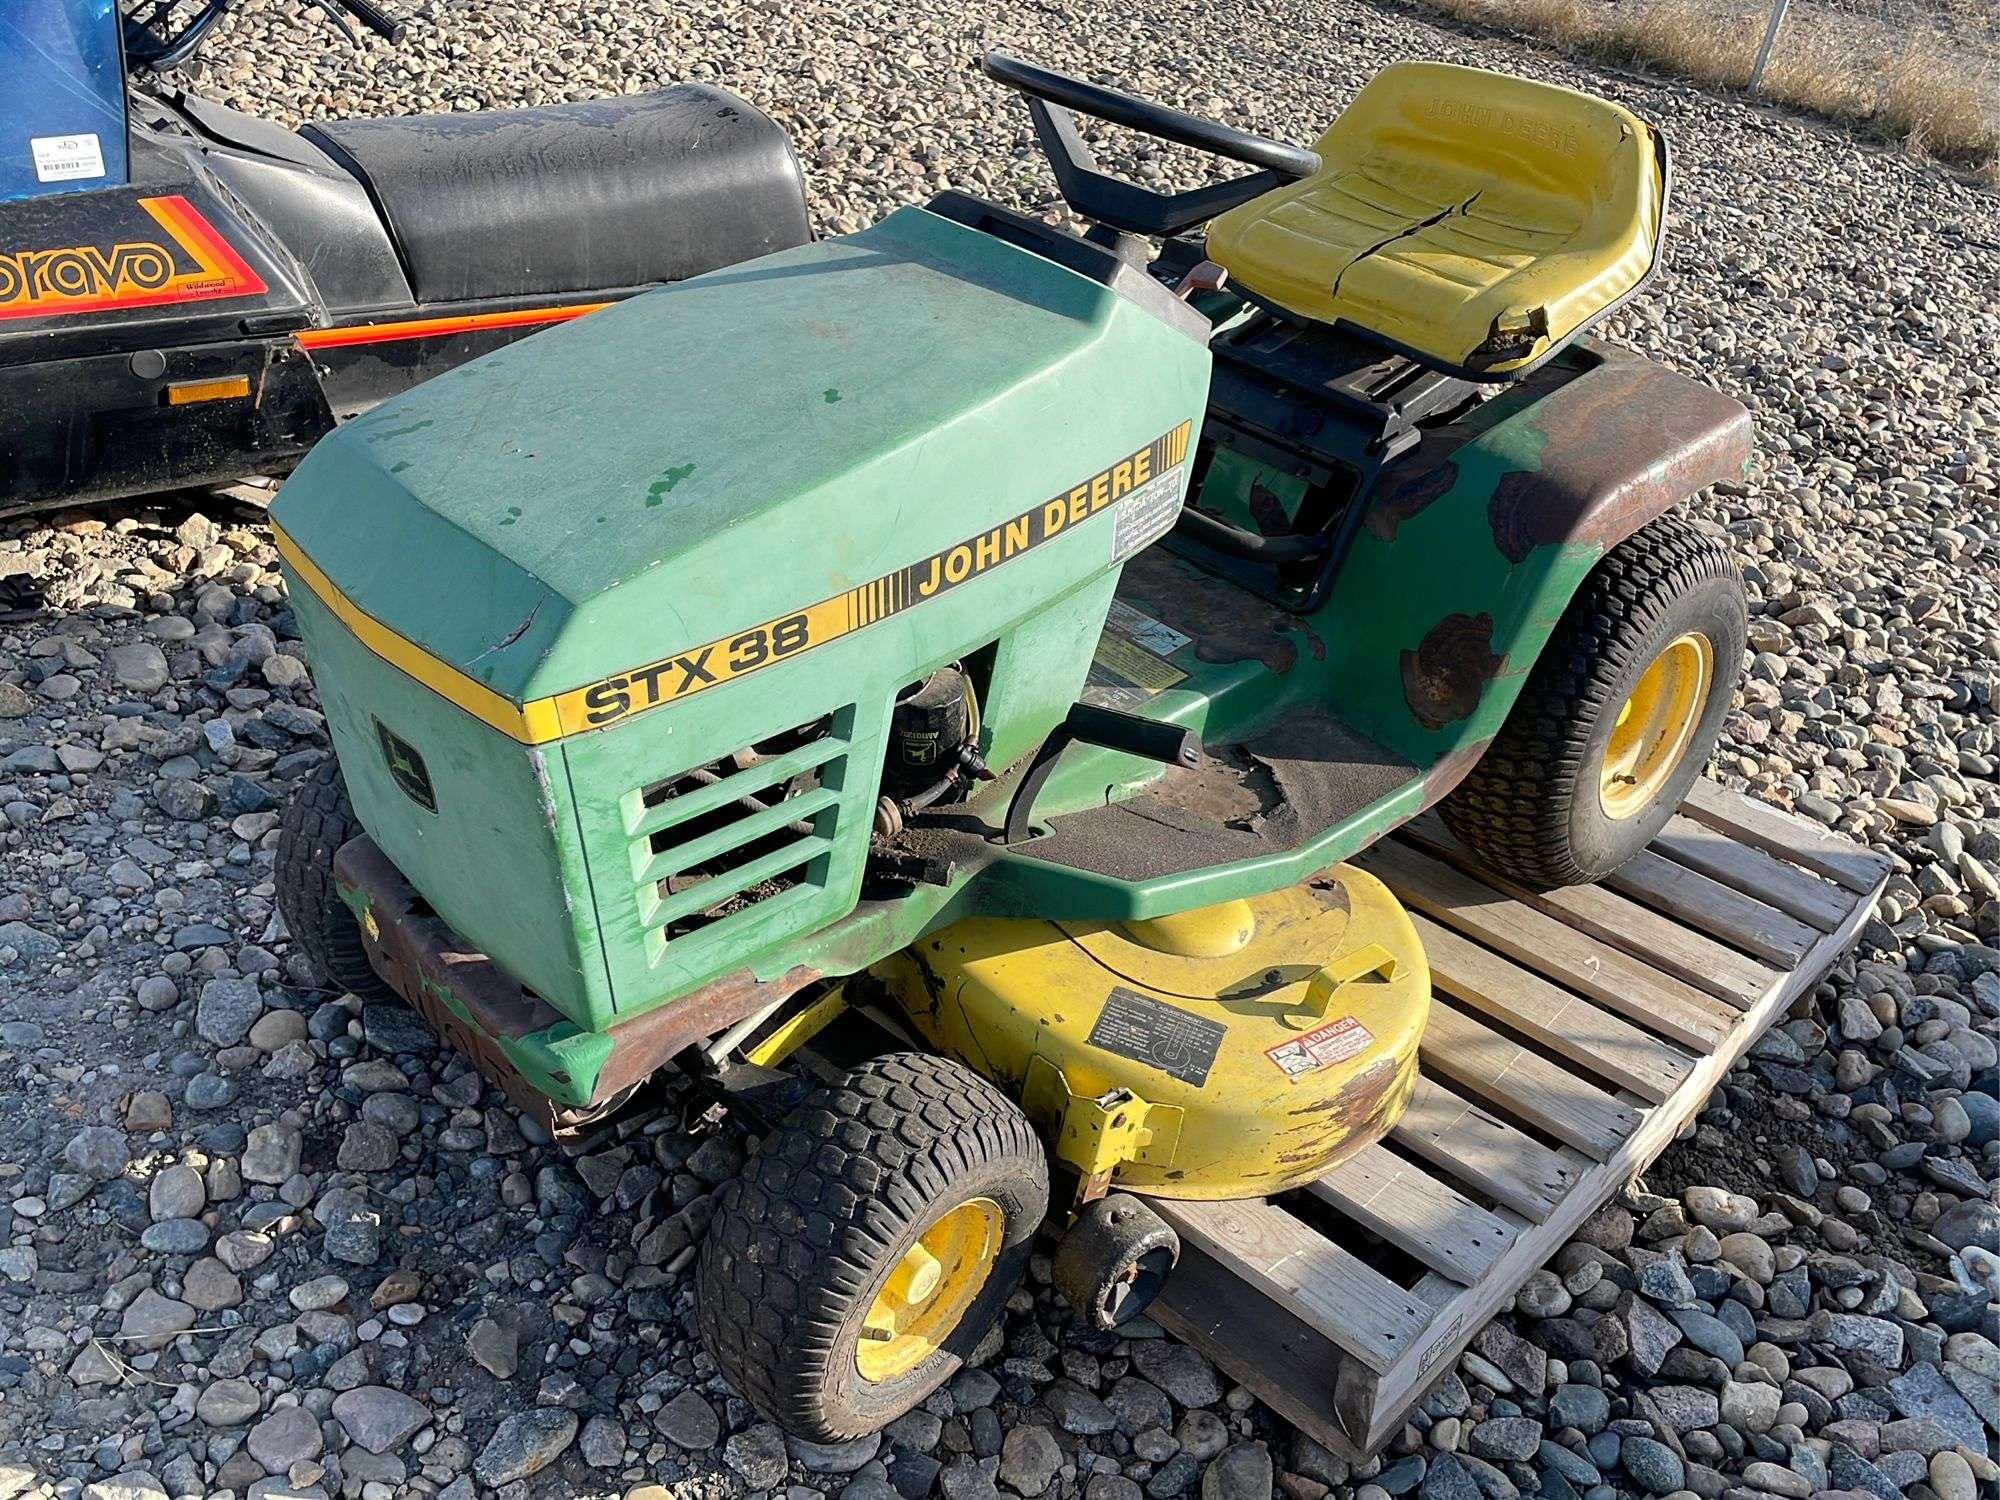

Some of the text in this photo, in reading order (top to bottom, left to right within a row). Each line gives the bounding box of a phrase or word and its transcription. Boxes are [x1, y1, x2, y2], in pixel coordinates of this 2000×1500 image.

[1424, 98, 1578, 159] JOHN DEERE
[918, 515, 1030, 598] JOHN
[1043, 446, 1152, 539] DEERE
[585, 613, 810, 724] STX 38
[1314, 1018, 1357, 1043] DANGER
